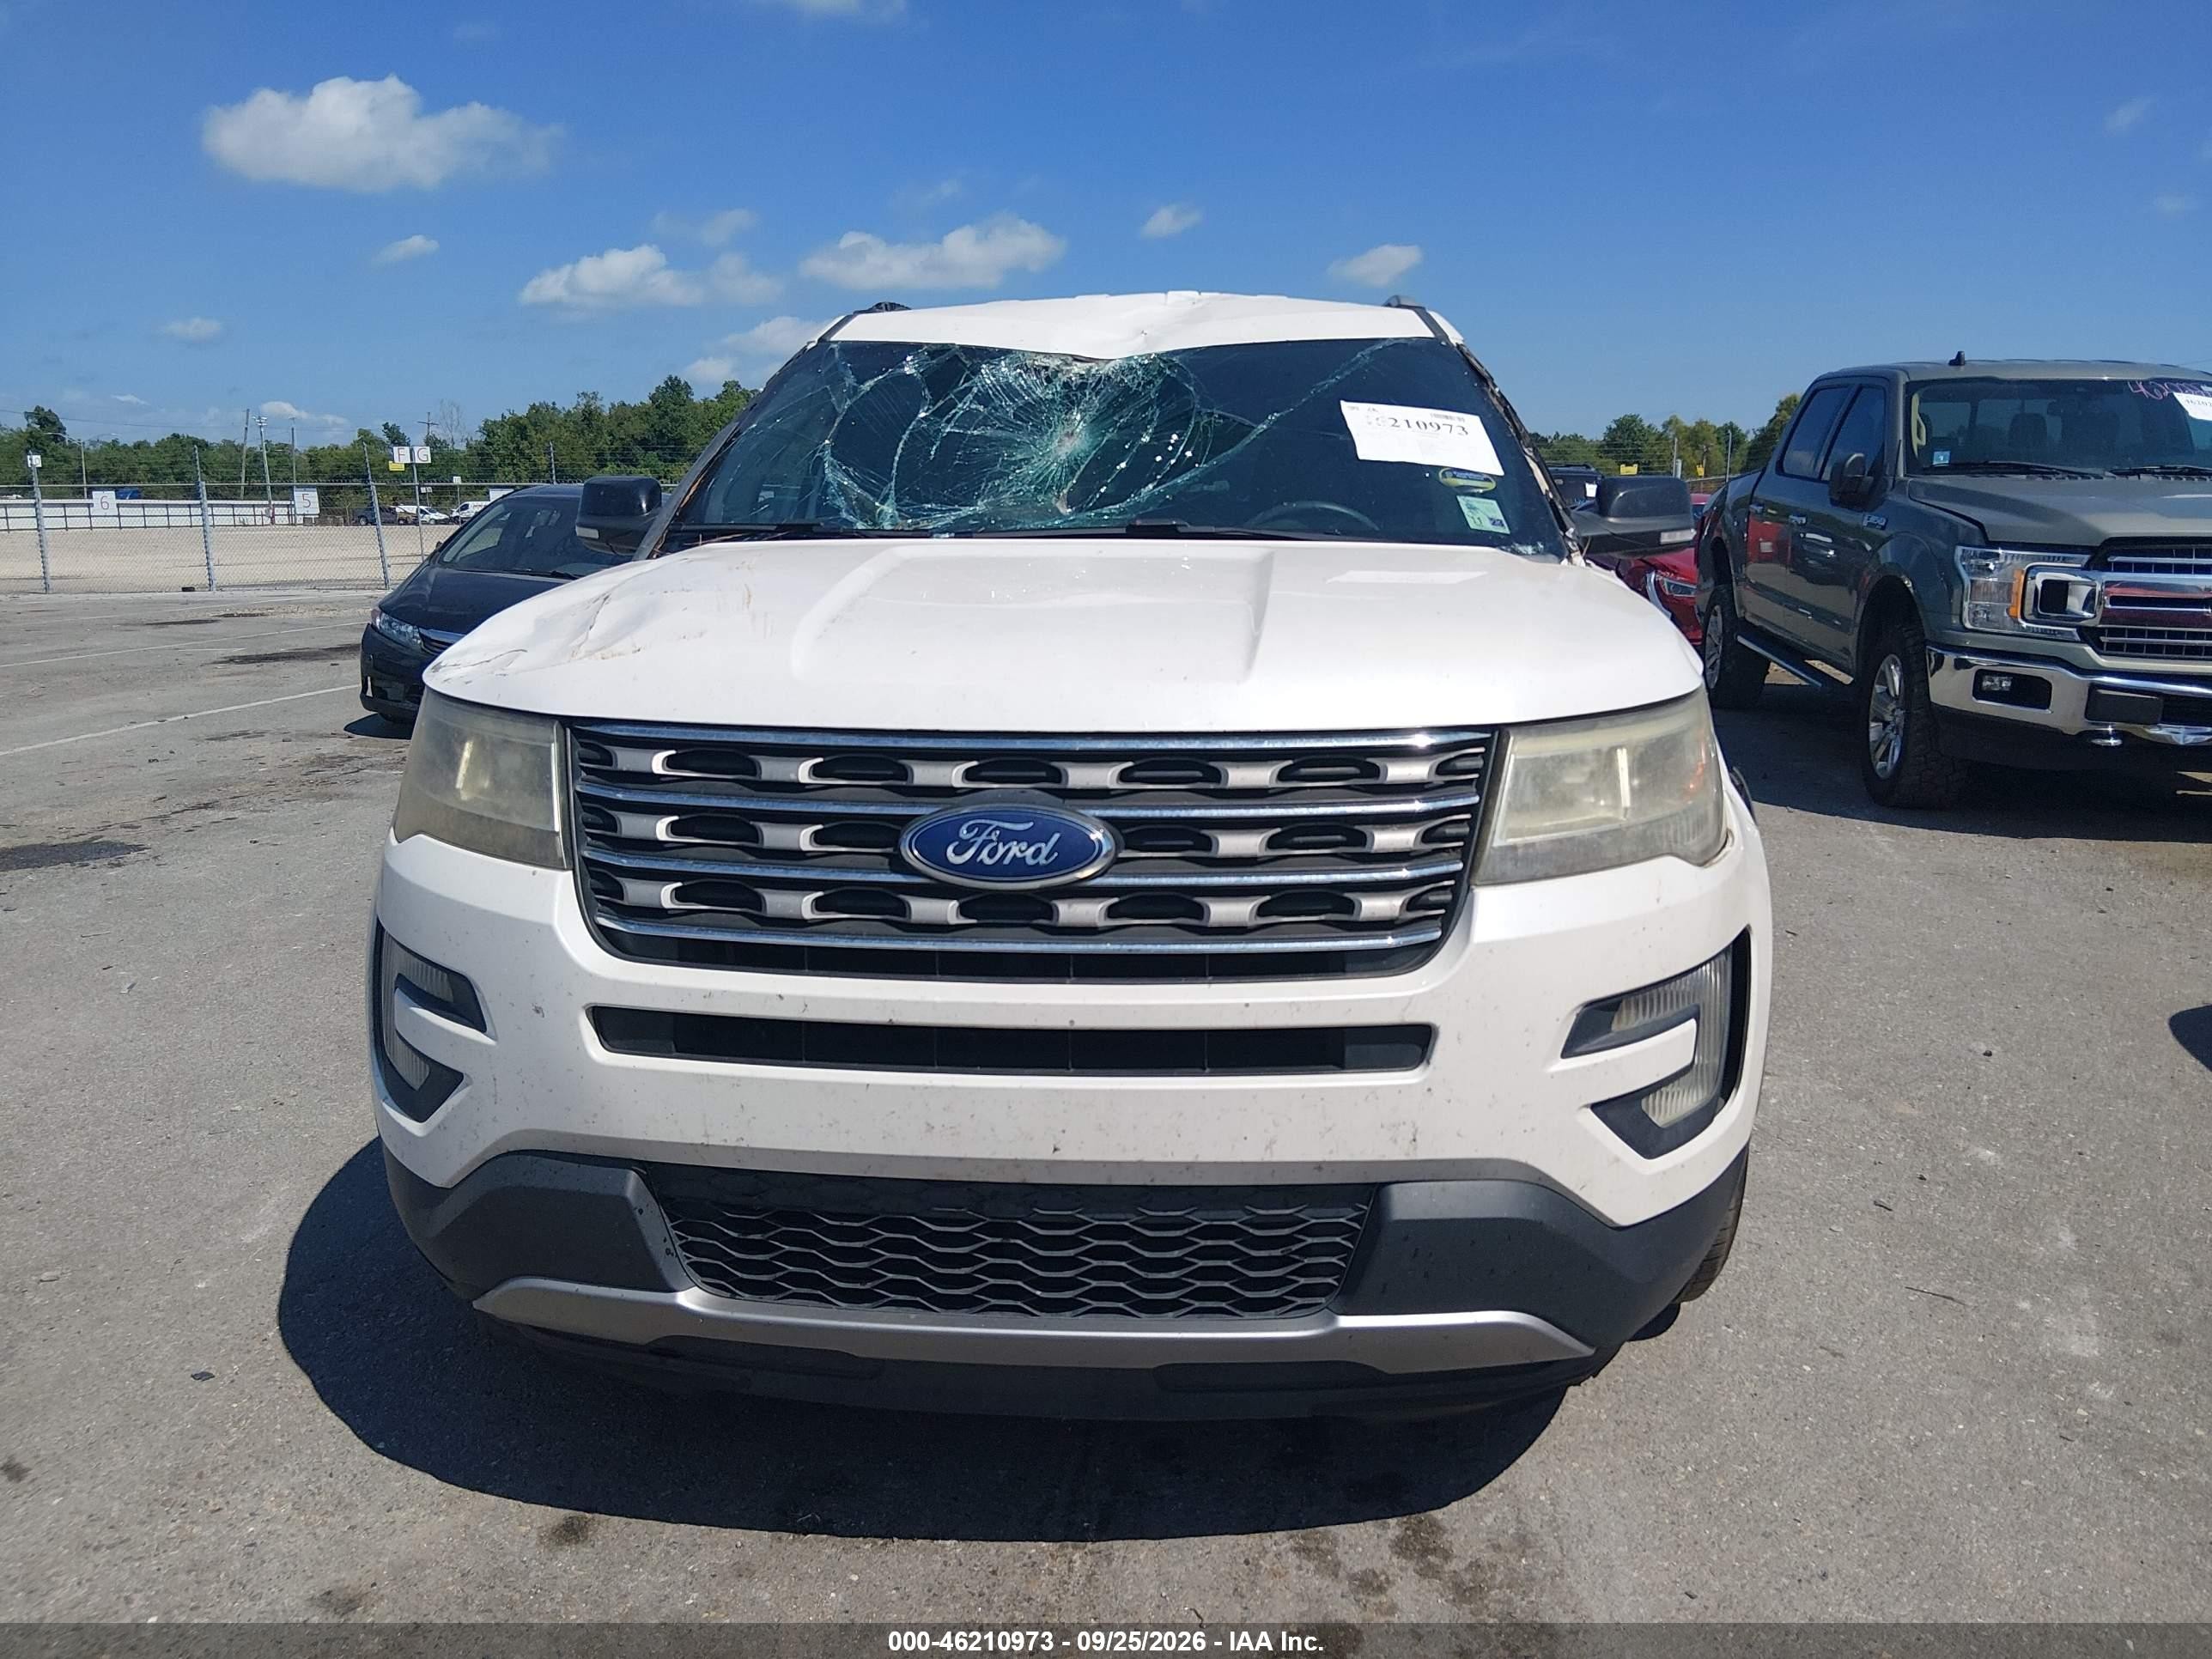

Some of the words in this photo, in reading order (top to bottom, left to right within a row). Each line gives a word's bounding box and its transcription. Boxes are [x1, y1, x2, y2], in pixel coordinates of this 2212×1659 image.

[397, 447, 406, 463] F
[416, 447, 429, 463] G
[100, 495, 110, 510] 6
[301, 493, 312, 508] 5
[945, 818, 1060, 866] Ford
